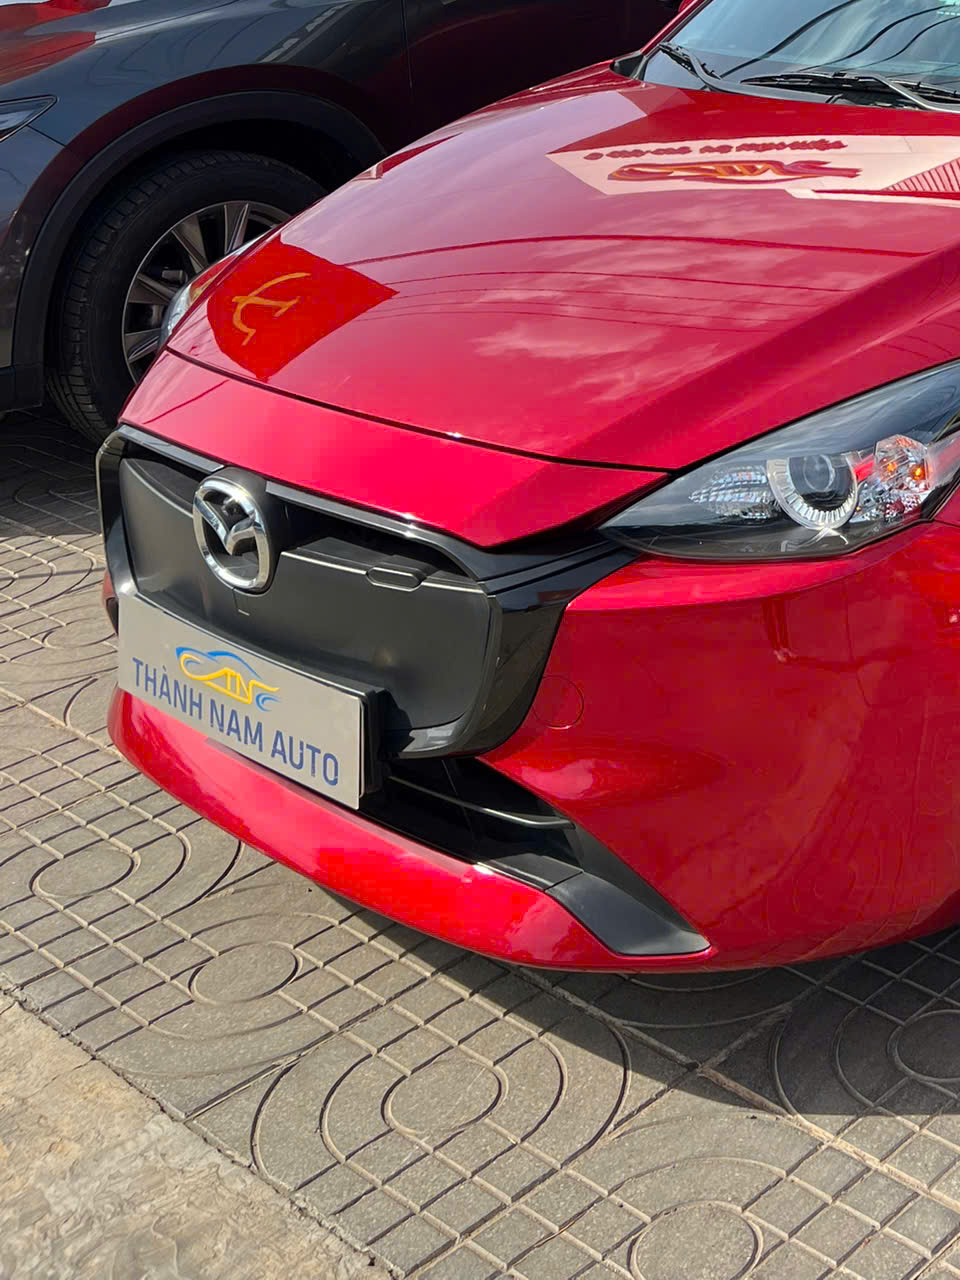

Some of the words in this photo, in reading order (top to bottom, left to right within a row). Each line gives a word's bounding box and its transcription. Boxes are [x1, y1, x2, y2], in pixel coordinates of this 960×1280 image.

[132, 657, 203, 720] THÀNH
[210, 699, 264, 753] NAM
[271, 729, 339, 787] AUTO
